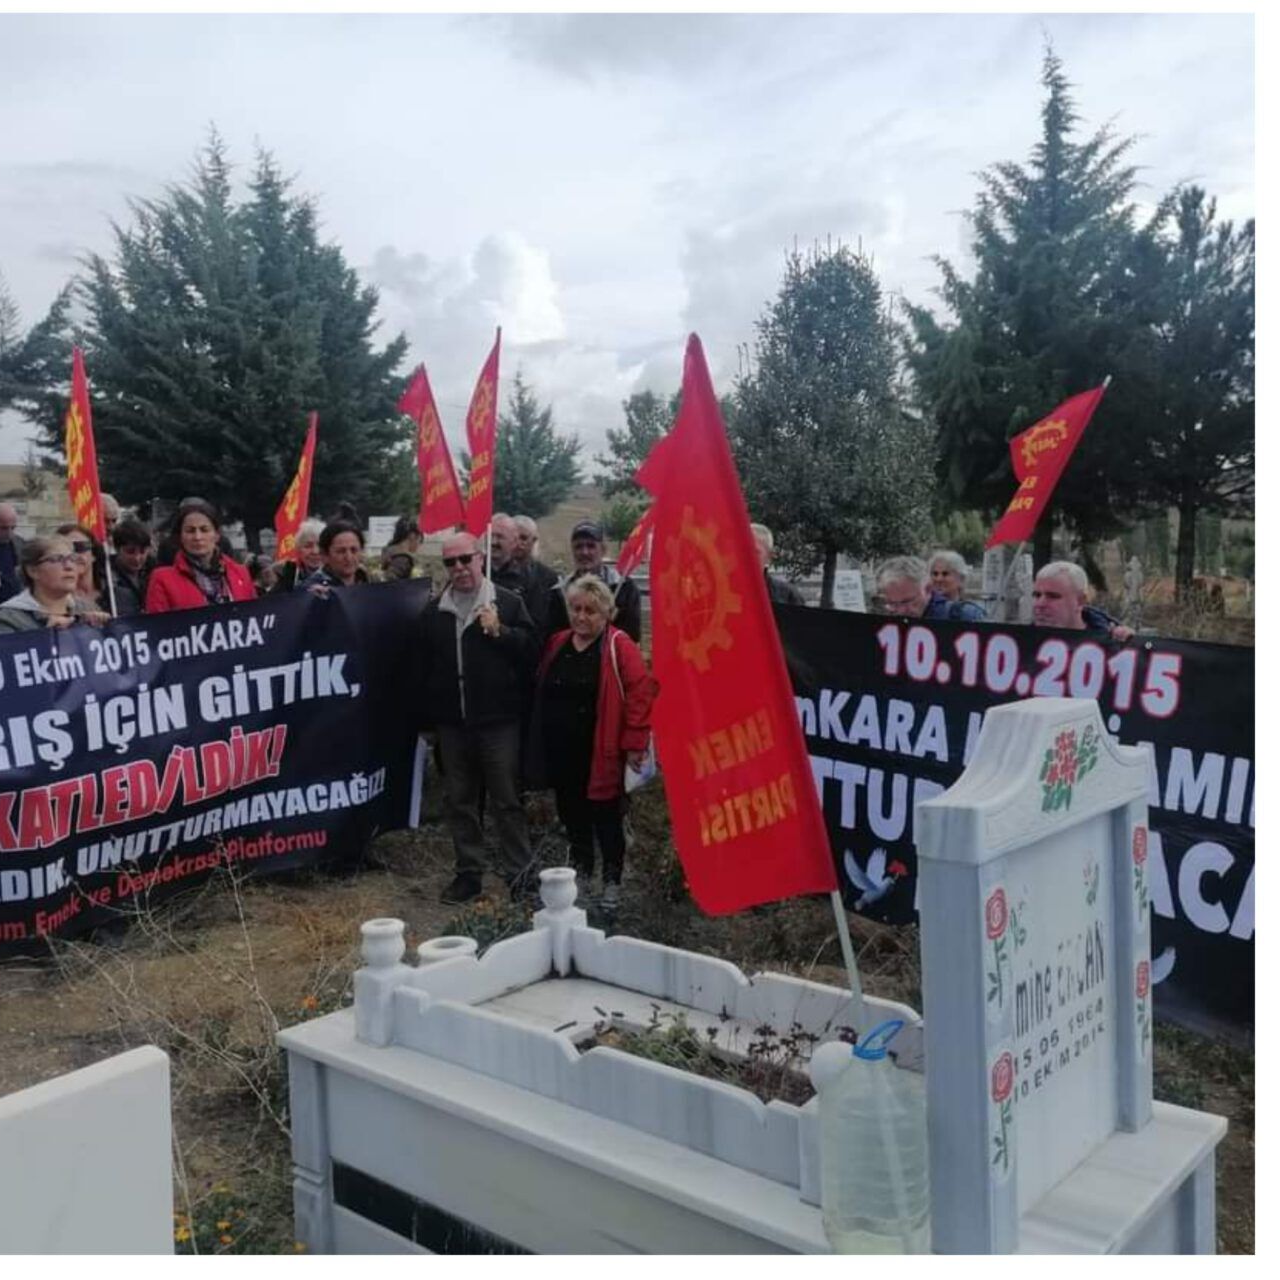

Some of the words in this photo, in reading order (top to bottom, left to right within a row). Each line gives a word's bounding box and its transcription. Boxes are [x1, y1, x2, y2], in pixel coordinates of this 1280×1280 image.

[13, 646, 86, 687] Ekim
[89, 631, 151, 674] 2015
[84, 683, 187, 754] İÇİN
[198, 650, 362, 722] GİTTİK,
[877, 623, 1183, 718] 10.10.2015
[77, 767, 387, 876] UNUTTURMAYACAĞIZ!
[35, 894, 82, 936] Emek
[89, 887, 113, 907] ve
[117, 849, 221, 898] Demokrasi
[226, 828, 328, 864] Platformu
